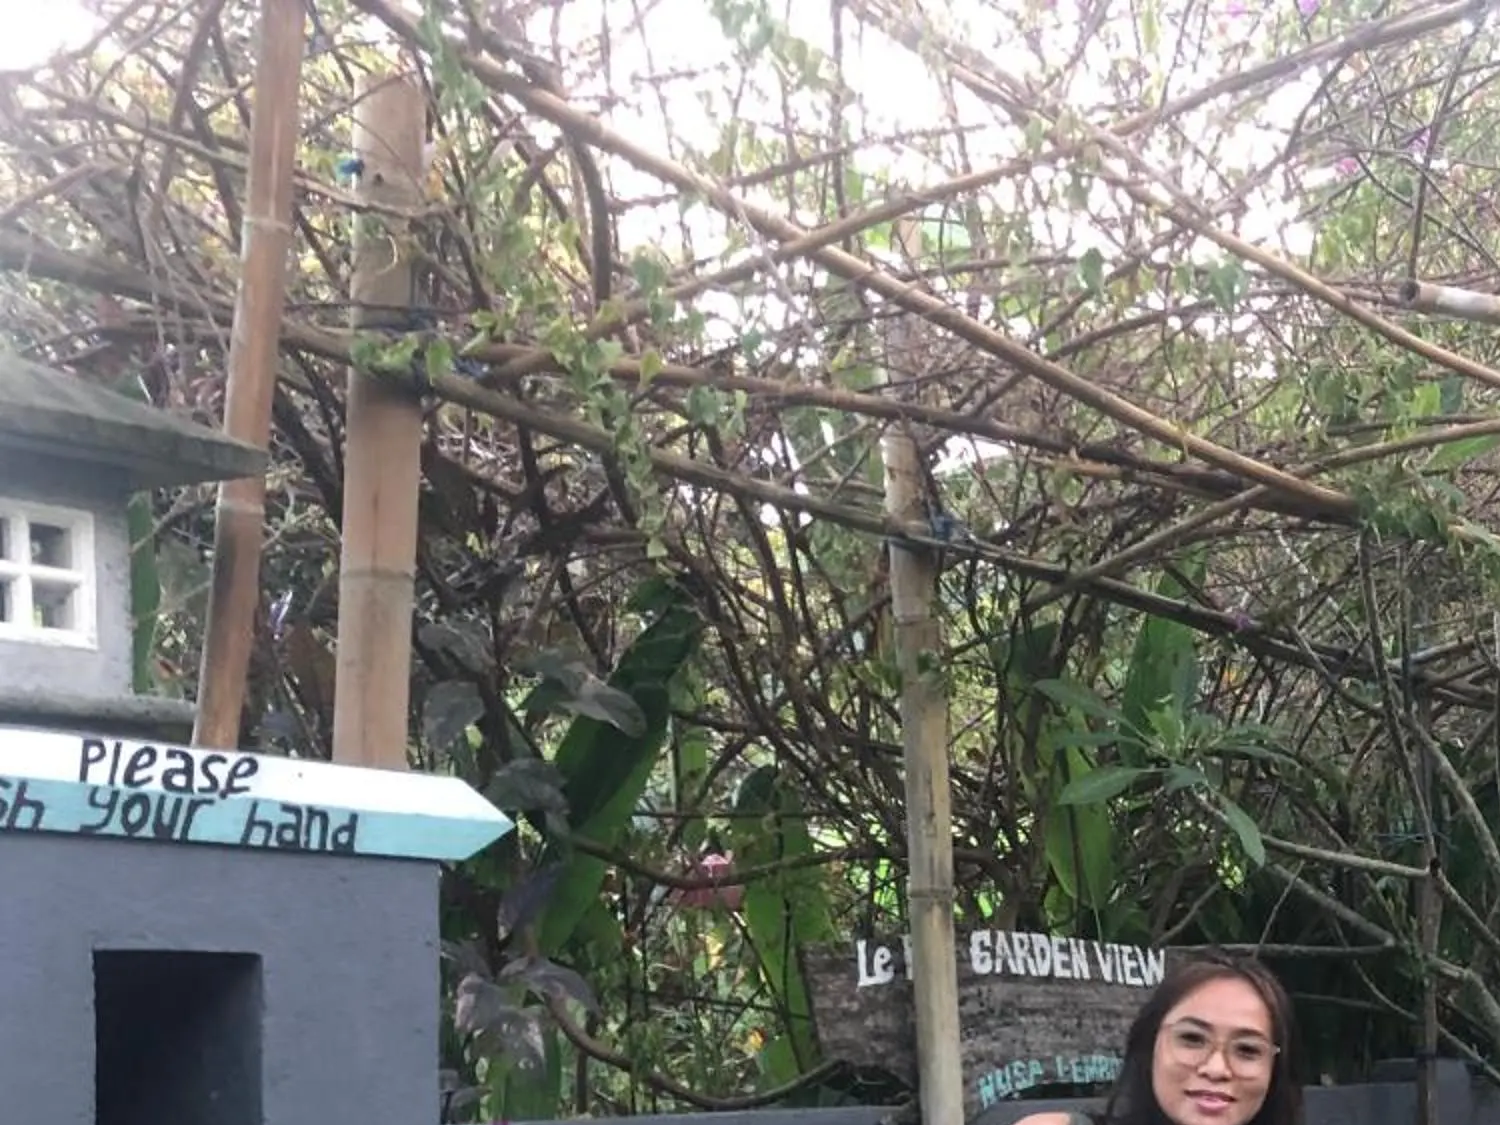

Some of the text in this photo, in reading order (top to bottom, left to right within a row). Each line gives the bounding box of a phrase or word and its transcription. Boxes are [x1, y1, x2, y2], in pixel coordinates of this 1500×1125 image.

[79, 738, 258, 797] Please
[79, 785, 214, 841] your
[240, 802, 359, 852] hand
[970, 929, 1091, 980] GARDEN
[1090, 941, 1165, 986] VIEW
